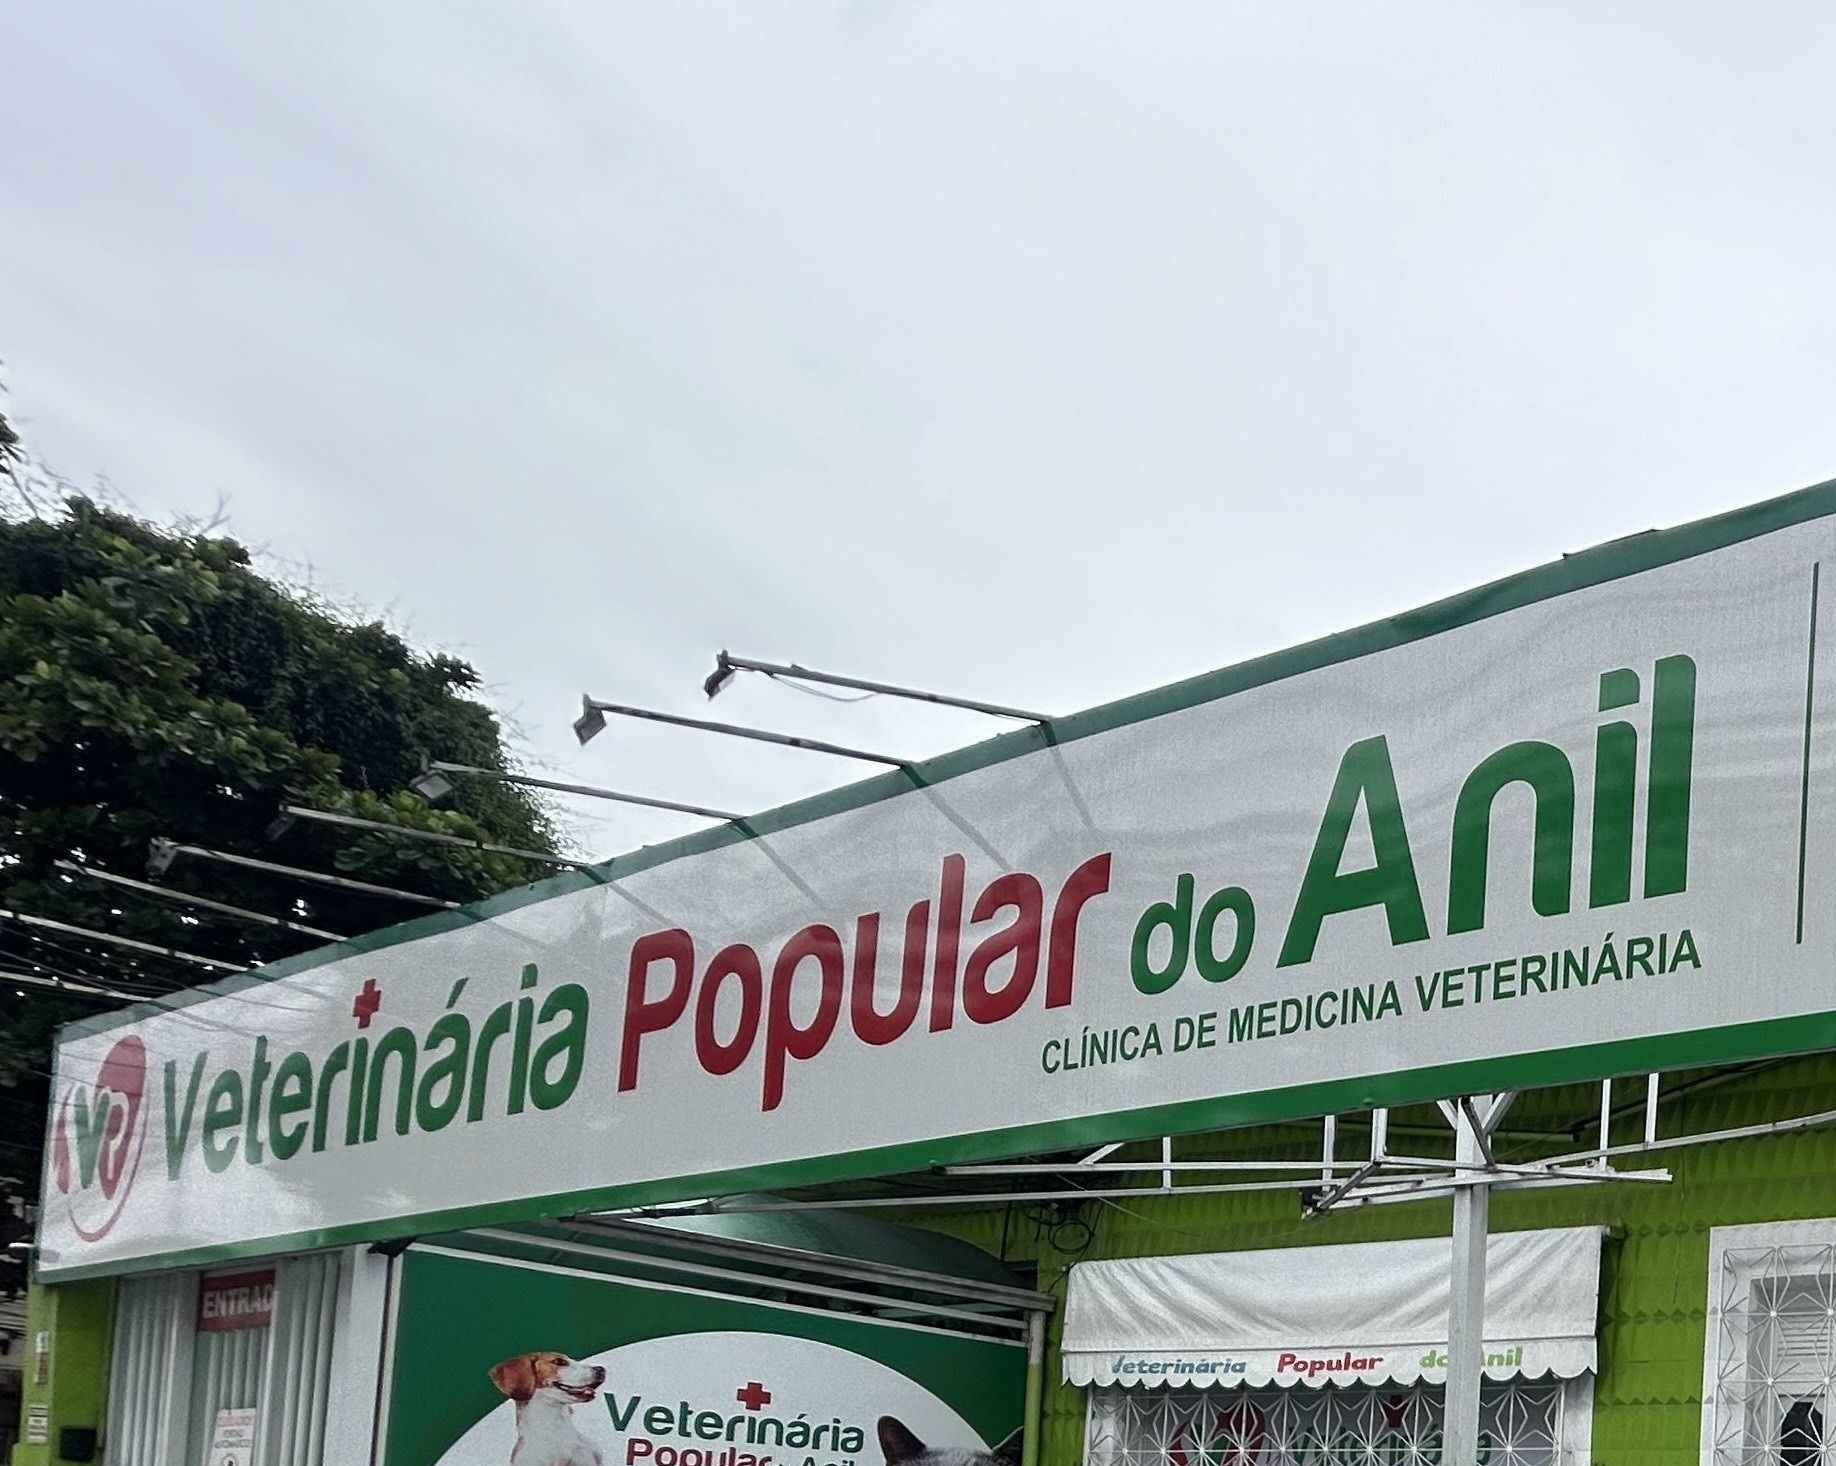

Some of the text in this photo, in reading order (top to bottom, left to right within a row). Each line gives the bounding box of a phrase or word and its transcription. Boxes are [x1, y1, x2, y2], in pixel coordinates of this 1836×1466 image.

[163, 655, 1696, 1181] Veterinária Popular do Anil
[1042, 929, 1702, 1074] CLÍNICA DE MEDICINA VETERINÁRIA
[1278, 1352, 1384, 1377] Popular
[1481, 1347, 1523, 1366] nil
[604, 1393, 865, 1453] Veterinária
